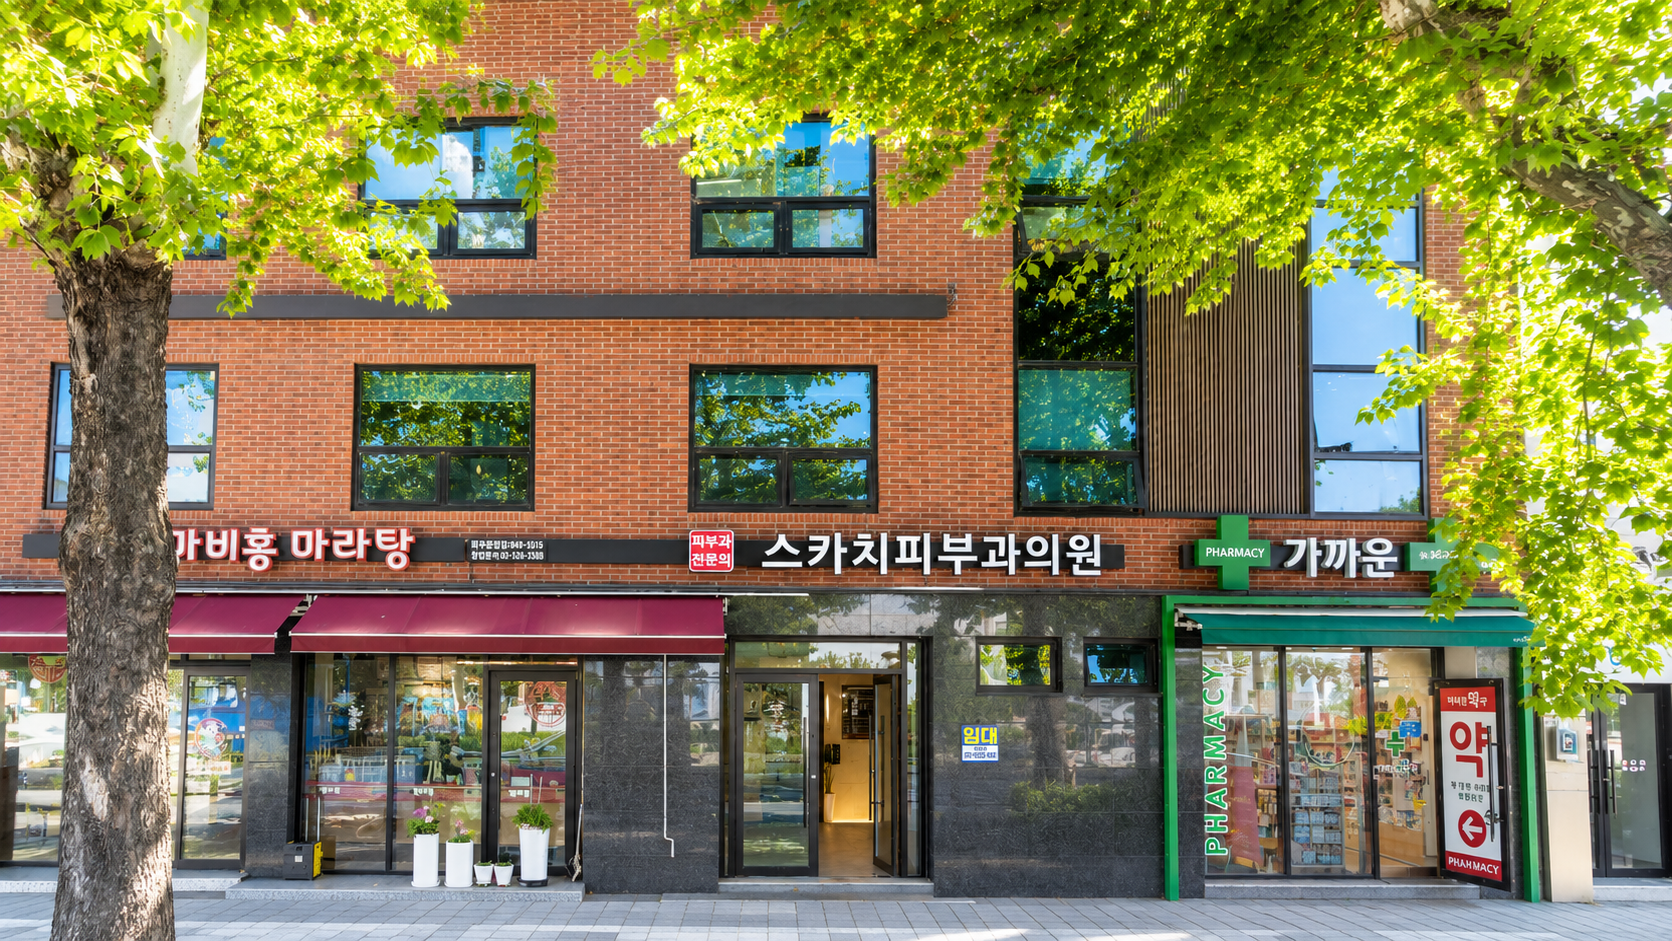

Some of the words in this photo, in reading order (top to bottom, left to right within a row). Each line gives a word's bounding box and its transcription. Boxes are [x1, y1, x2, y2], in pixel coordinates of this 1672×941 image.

[290, 527, 416, 571] 마라탕
[691, 534, 732, 549] 피부과
[691, 553, 731, 568] 전문의
[761, 532, 1101, 576] 스카치피부과의원
[1205, 547, 1265, 558] PHARMACY
[1283, 537, 1398, 578] 가까운
[963, 727, 998, 745] 임대
[1449, 721, 1489, 778] 약
[1202, 664, 1229, 856] PHARMACY
